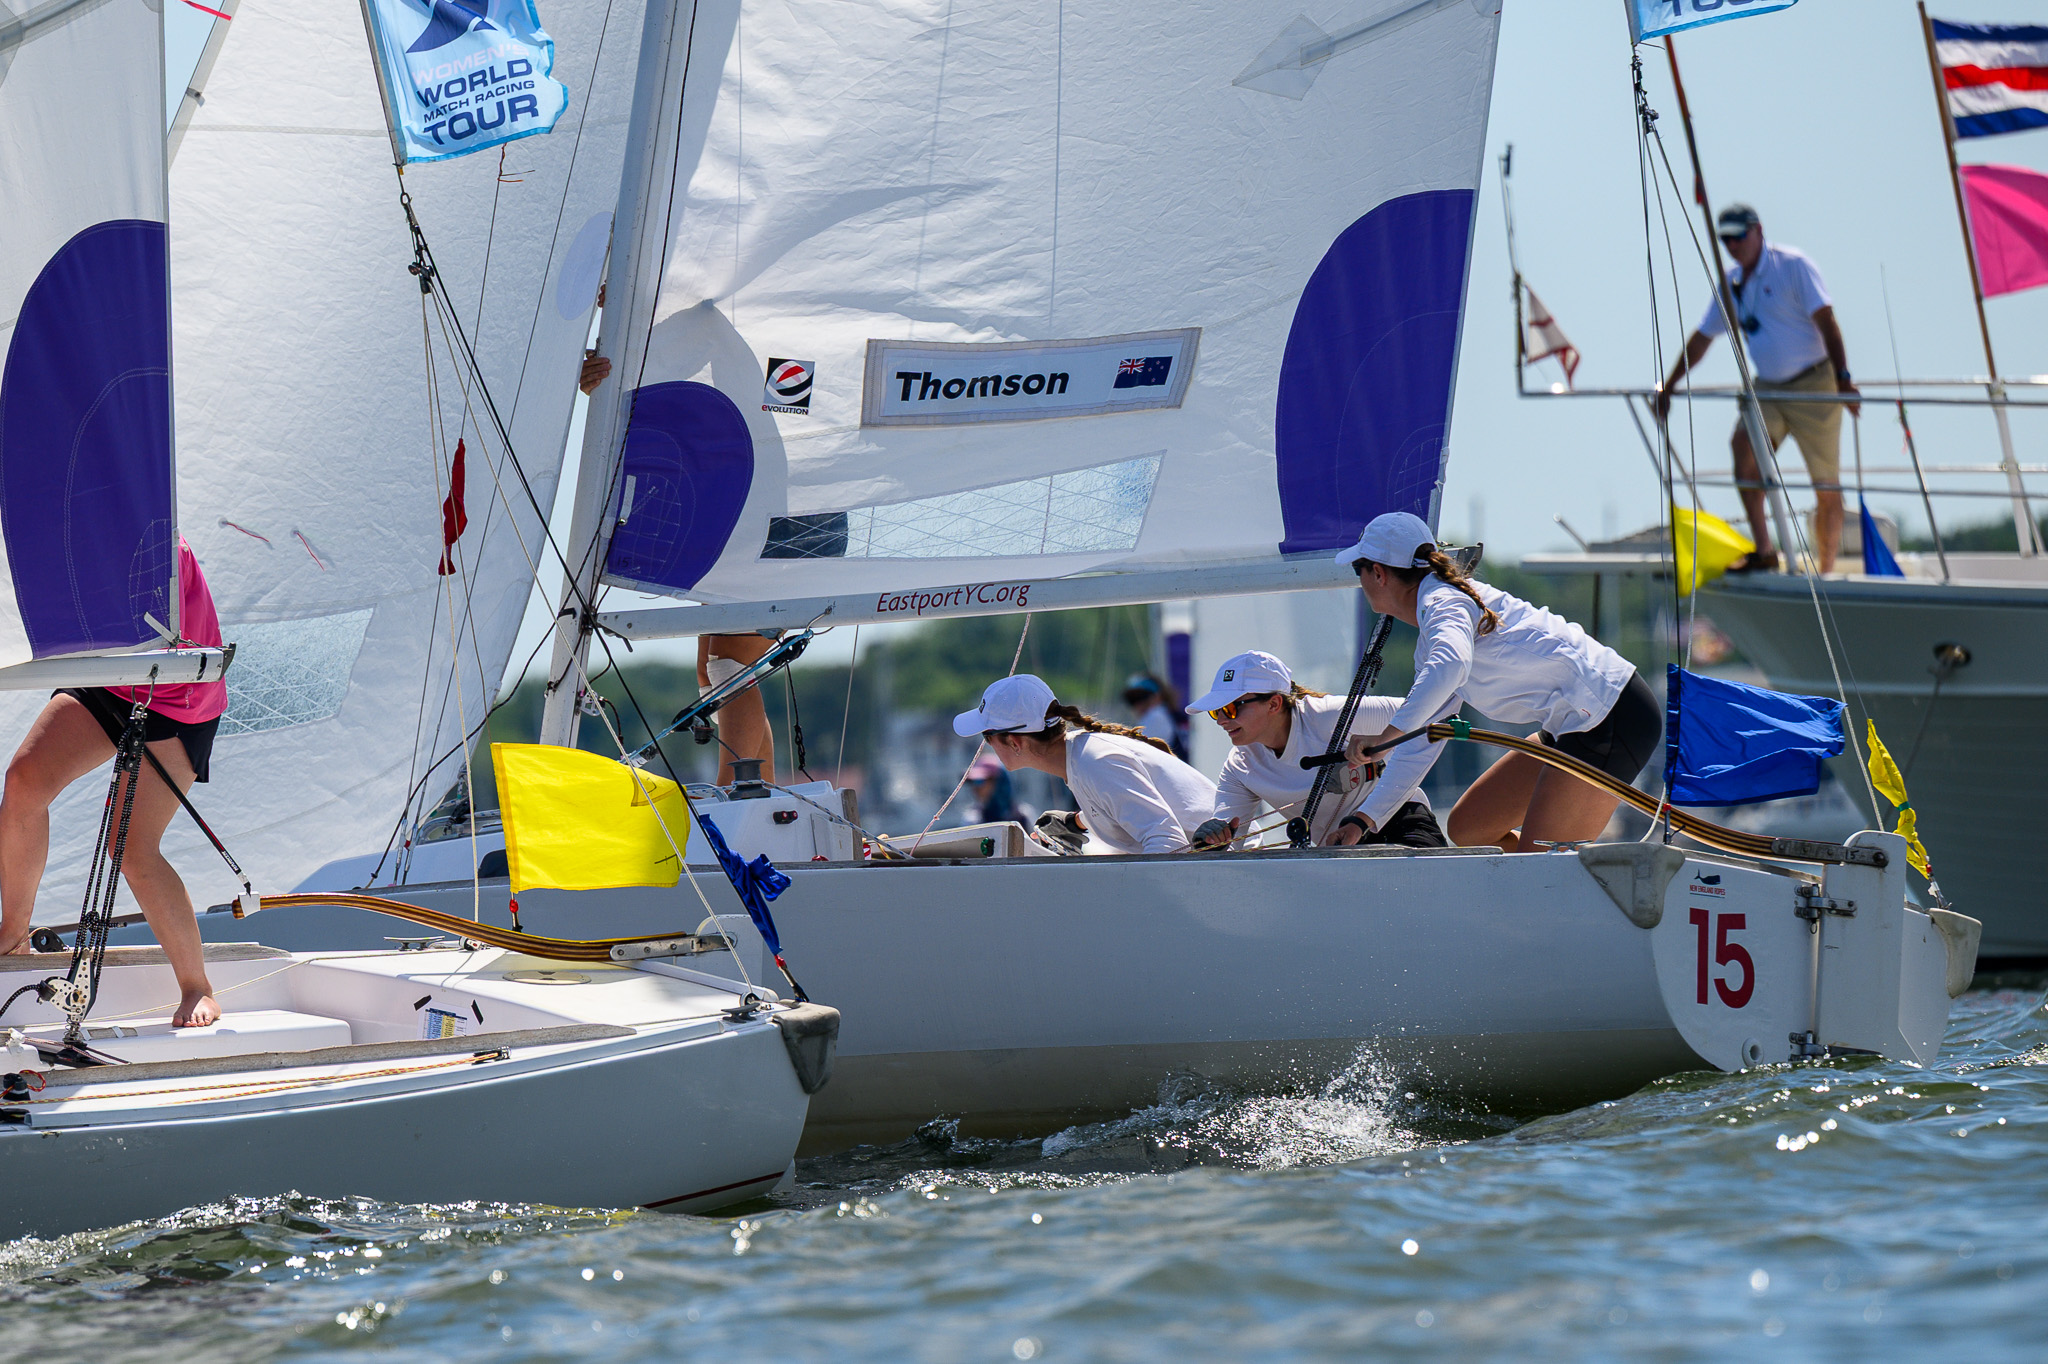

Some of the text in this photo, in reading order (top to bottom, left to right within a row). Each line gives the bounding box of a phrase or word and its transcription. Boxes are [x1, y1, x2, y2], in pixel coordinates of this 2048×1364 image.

[412, 43, 530, 85] WOMEN'S
[416, 58, 533, 108] WORLD
[423, 80, 535, 123] MATCH RACING
[423, 93, 539, 145] TOUR
[895, 371, 1070, 402] Thomson
[876, 583, 1031, 616] EastportYC.org
[1689, 907, 1755, 1009] 15
